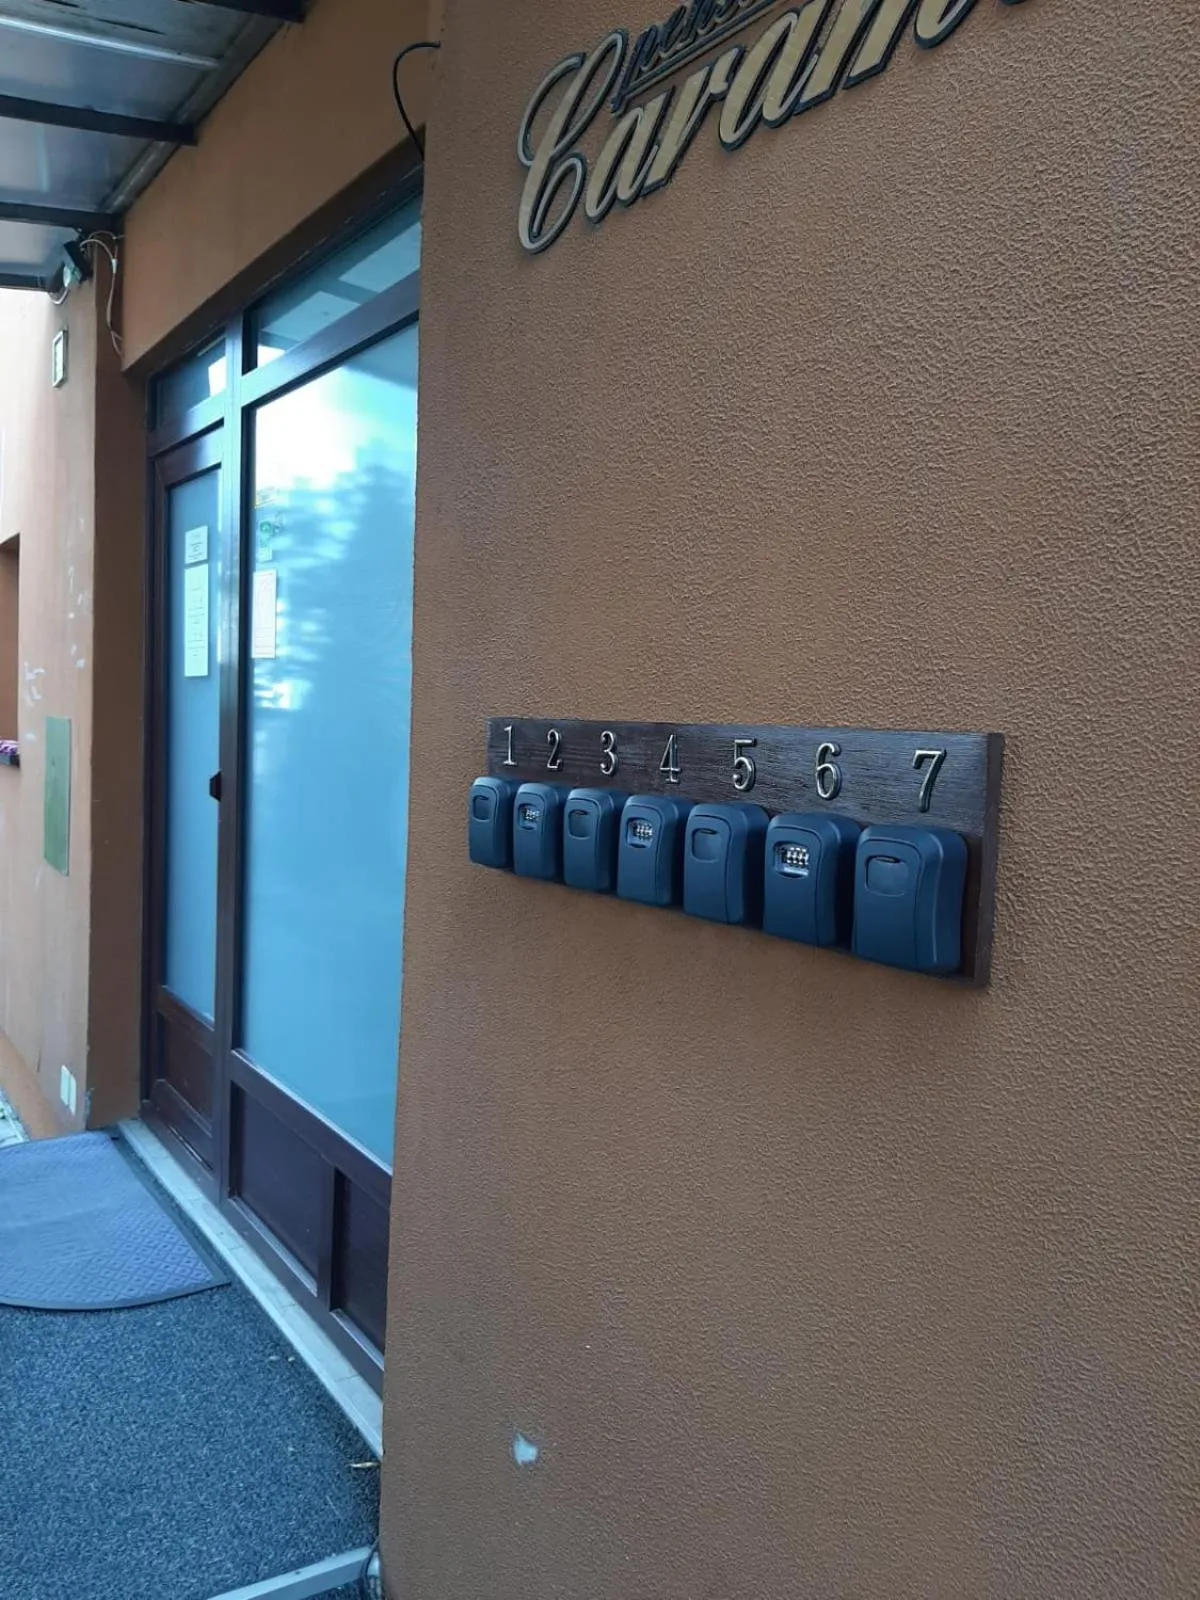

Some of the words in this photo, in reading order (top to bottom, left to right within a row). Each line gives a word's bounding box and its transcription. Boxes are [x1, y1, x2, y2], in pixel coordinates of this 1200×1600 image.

[503, 725, 517, 766] 1
[547, 728, 563, 770] 2
[600, 730, 618, 776] 3
[659, 734, 681, 784] 4
[732, 738, 757, 791] 5
[815, 742, 842, 800] 6
[912, 749, 947, 813] 7
